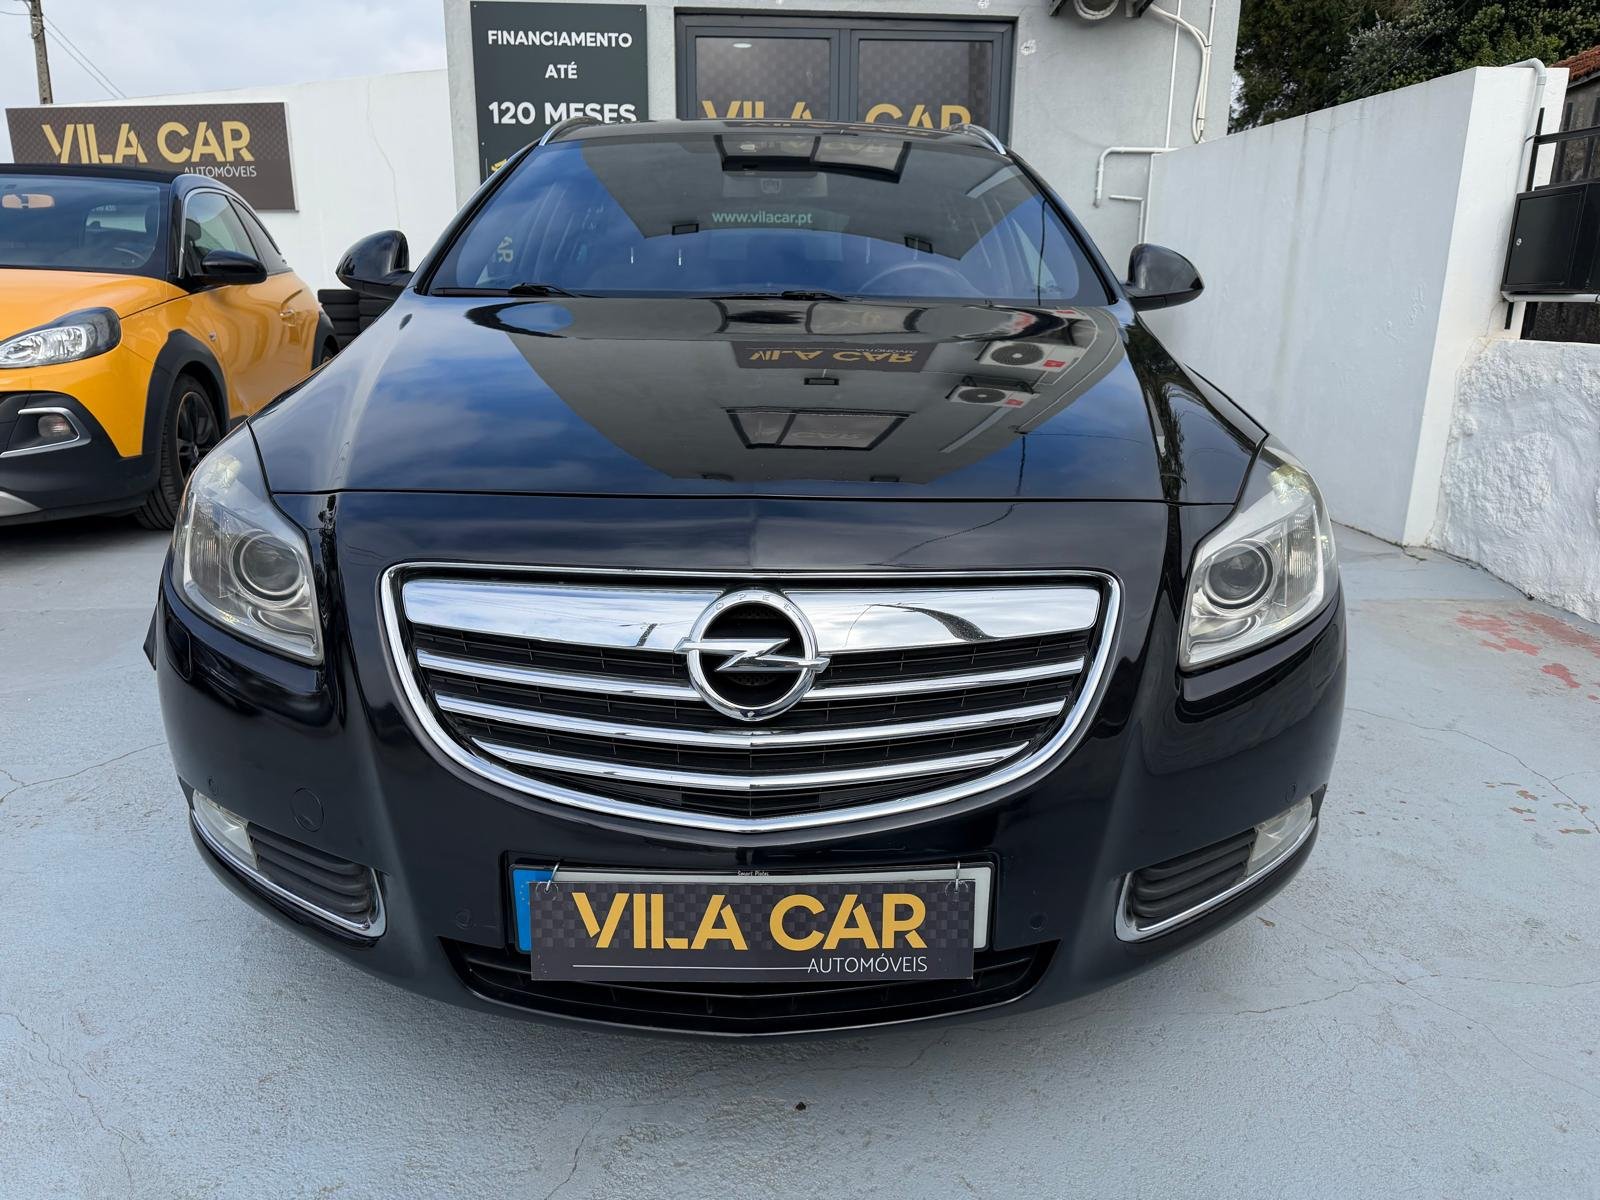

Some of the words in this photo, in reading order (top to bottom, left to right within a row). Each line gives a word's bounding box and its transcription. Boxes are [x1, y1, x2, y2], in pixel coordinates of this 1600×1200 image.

[488, 30, 633, 48] FINANCIAMENTO
[545, 61, 578, 79] ATÉ
[488, 101, 536, 125] 120
[544, 102, 637, 125] MESES
[41, 123, 148, 164] VILA
[157, 121, 255, 164] CAR
[184, 163, 257, 177] AUTOMÓVEIS
[712, 211, 814, 226] www.vilacar.pt
[571, 892, 749, 950] VILA
[769, 893, 928, 951] CAR
[807, 953, 928, 973] AUTOMÓVEIS
